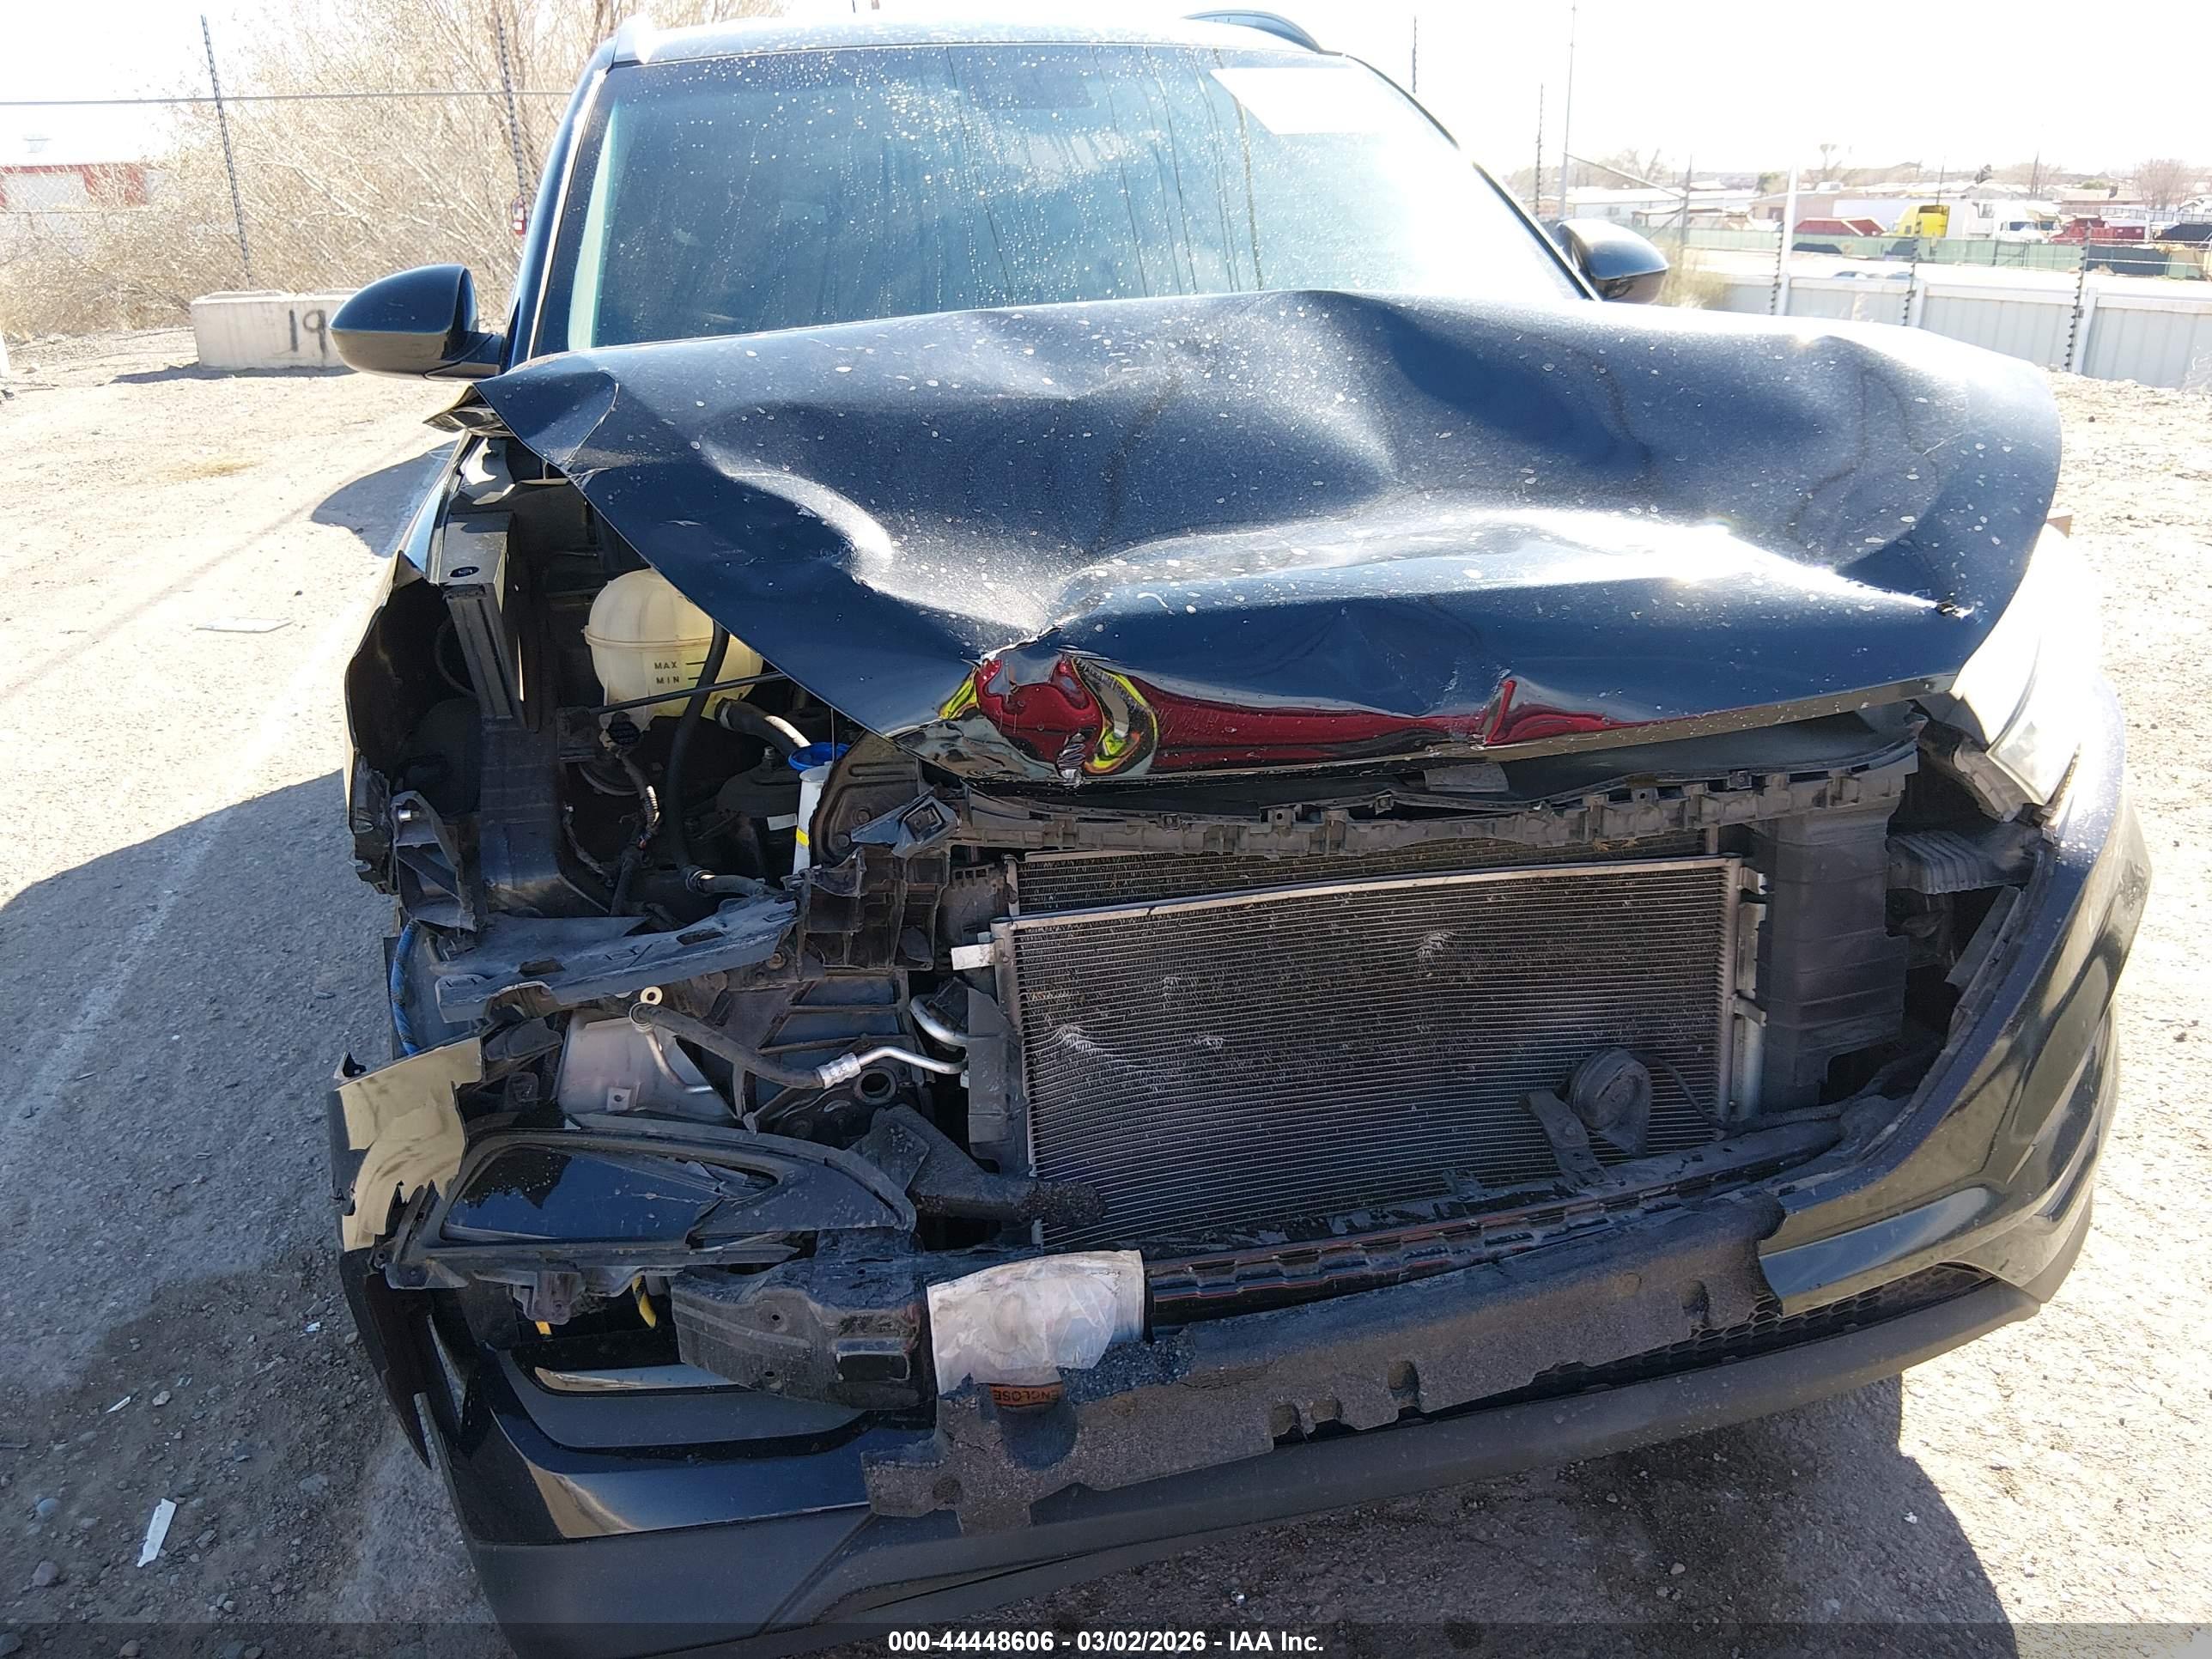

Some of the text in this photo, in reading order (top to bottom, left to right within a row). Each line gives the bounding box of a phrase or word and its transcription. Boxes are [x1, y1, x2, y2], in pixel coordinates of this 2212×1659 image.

[289, 308, 330, 359] 19
[654, 660, 678, 670] MAX
[656, 676, 680, 685] MIN
